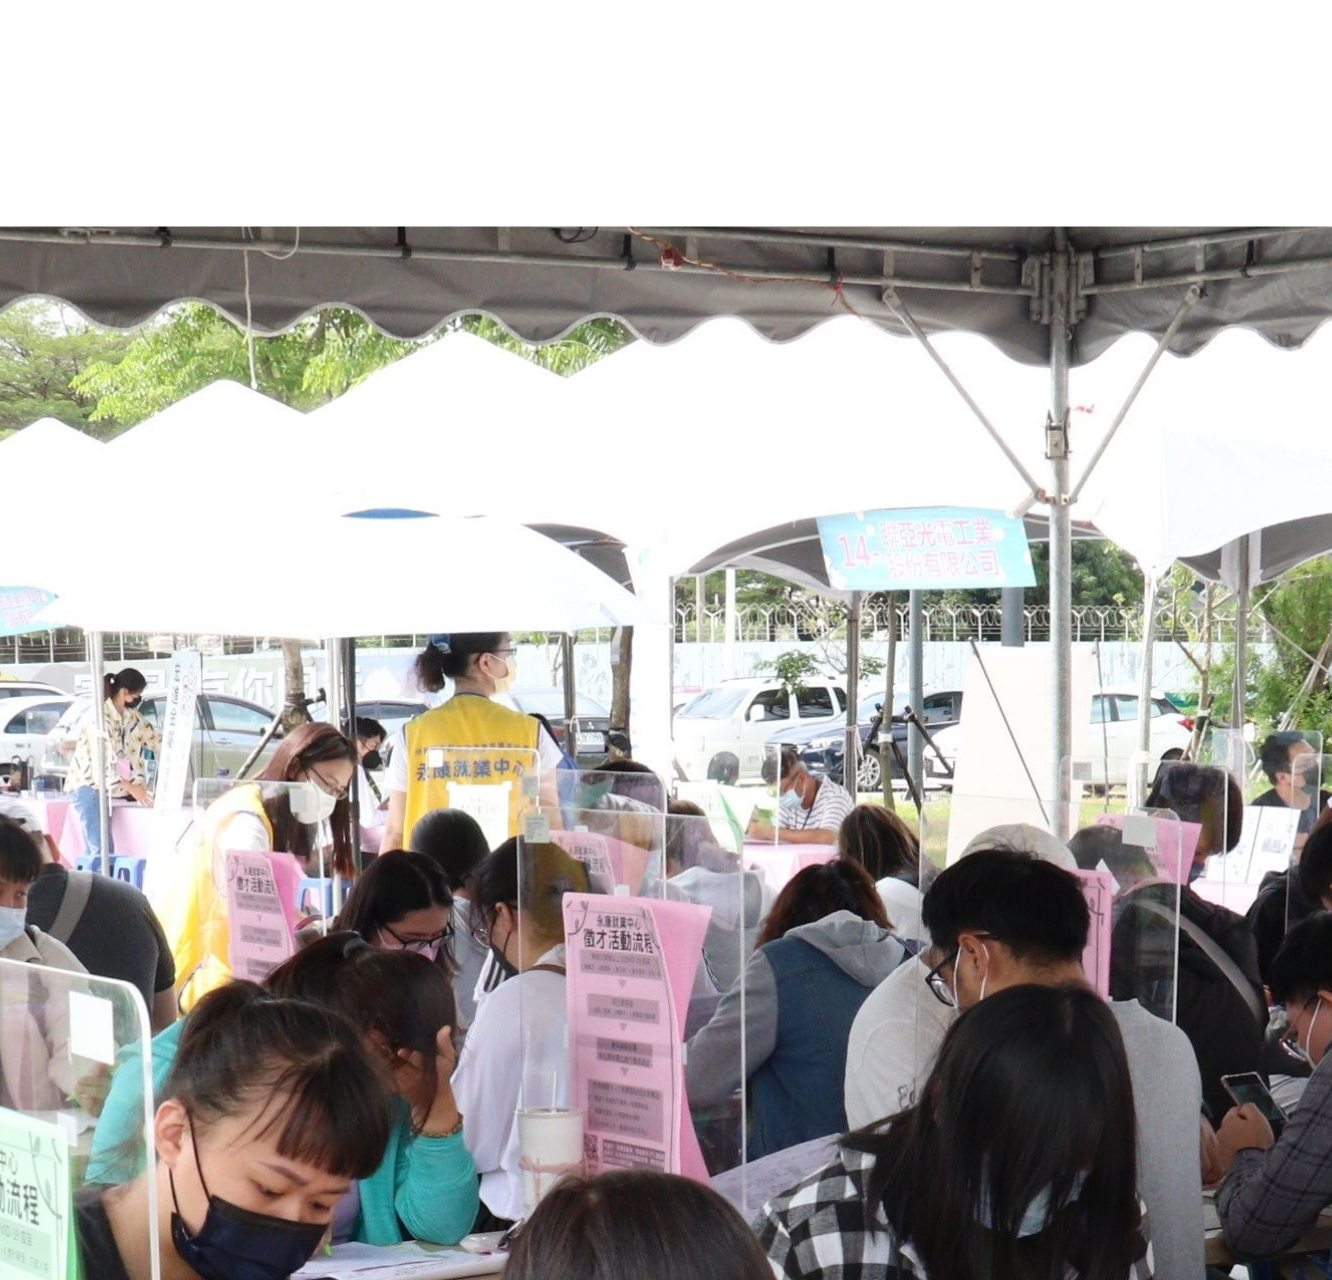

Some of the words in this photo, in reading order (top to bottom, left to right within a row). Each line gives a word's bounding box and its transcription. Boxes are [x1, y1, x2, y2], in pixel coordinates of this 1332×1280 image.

[886, 548, 1000, 579] 股份有限公司
[596, 914, 642, 931] 永康就業中心
[583, 928, 654, 954] 徵才活動流程
